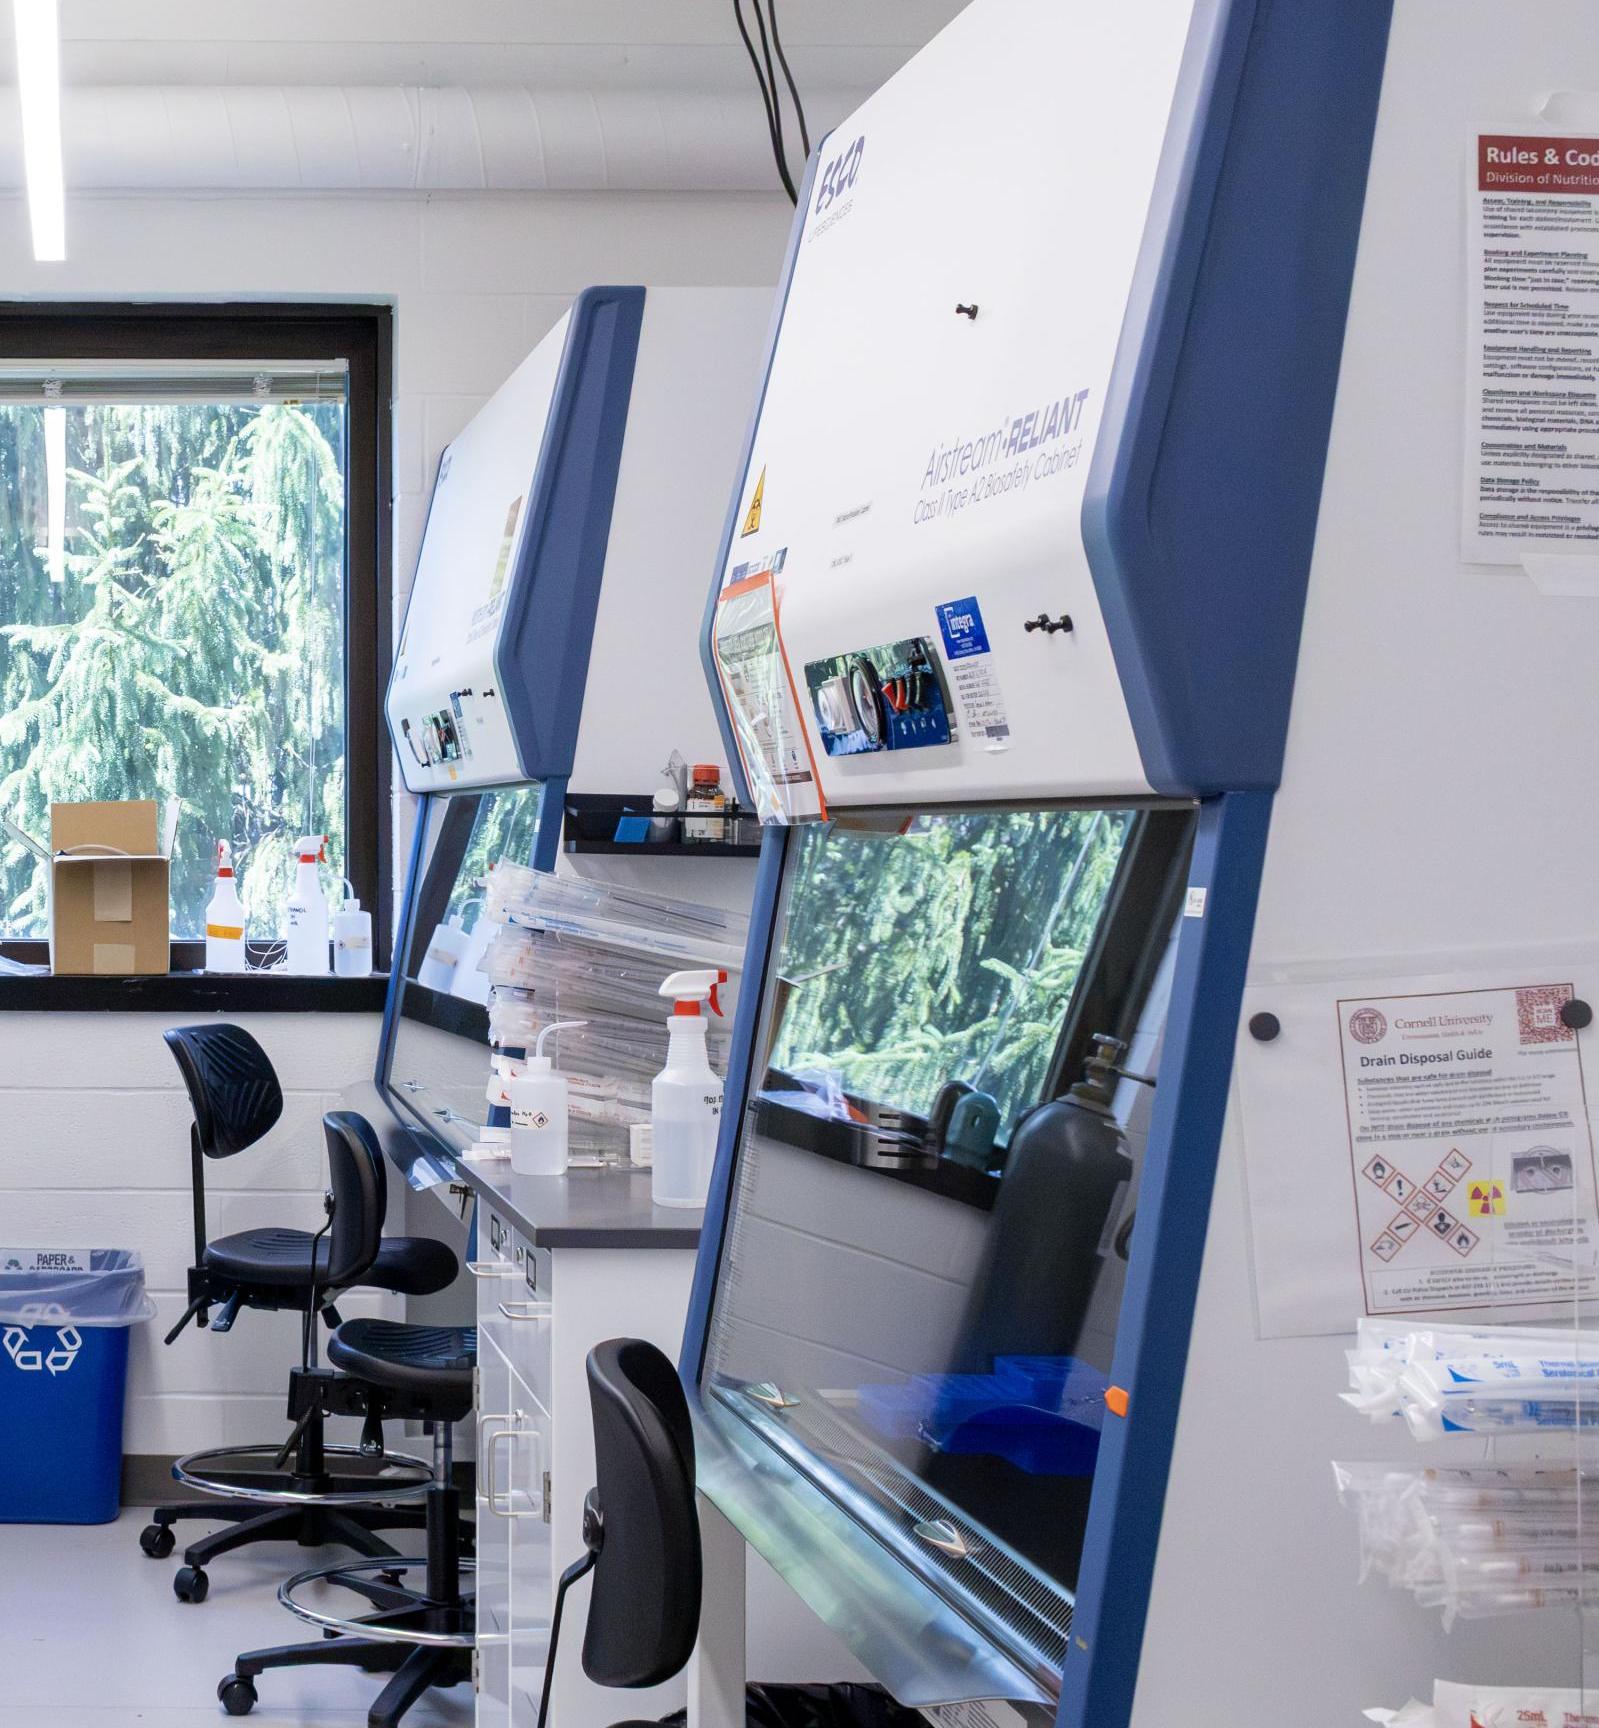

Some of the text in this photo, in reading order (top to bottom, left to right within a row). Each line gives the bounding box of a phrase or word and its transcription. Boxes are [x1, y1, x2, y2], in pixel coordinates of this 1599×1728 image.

[1487, 147, 1539, 164] Rules
[1544, 148, 1560, 165] &
[816, 135, 865, 216] ESCO
[1487, 171, 1534, 184] Division
[1537, 173, 1550, 184] of
[921, 388, 1090, 490] Airstream RELIANT
[1034, 438, 1083, 481] Cabinet
[1394, 1014, 1494, 1029] Cornell University
[1360, 1048, 1493, 1067] Drain Disposal Guide
[37, 1253, 75, 1266] PAPER &
